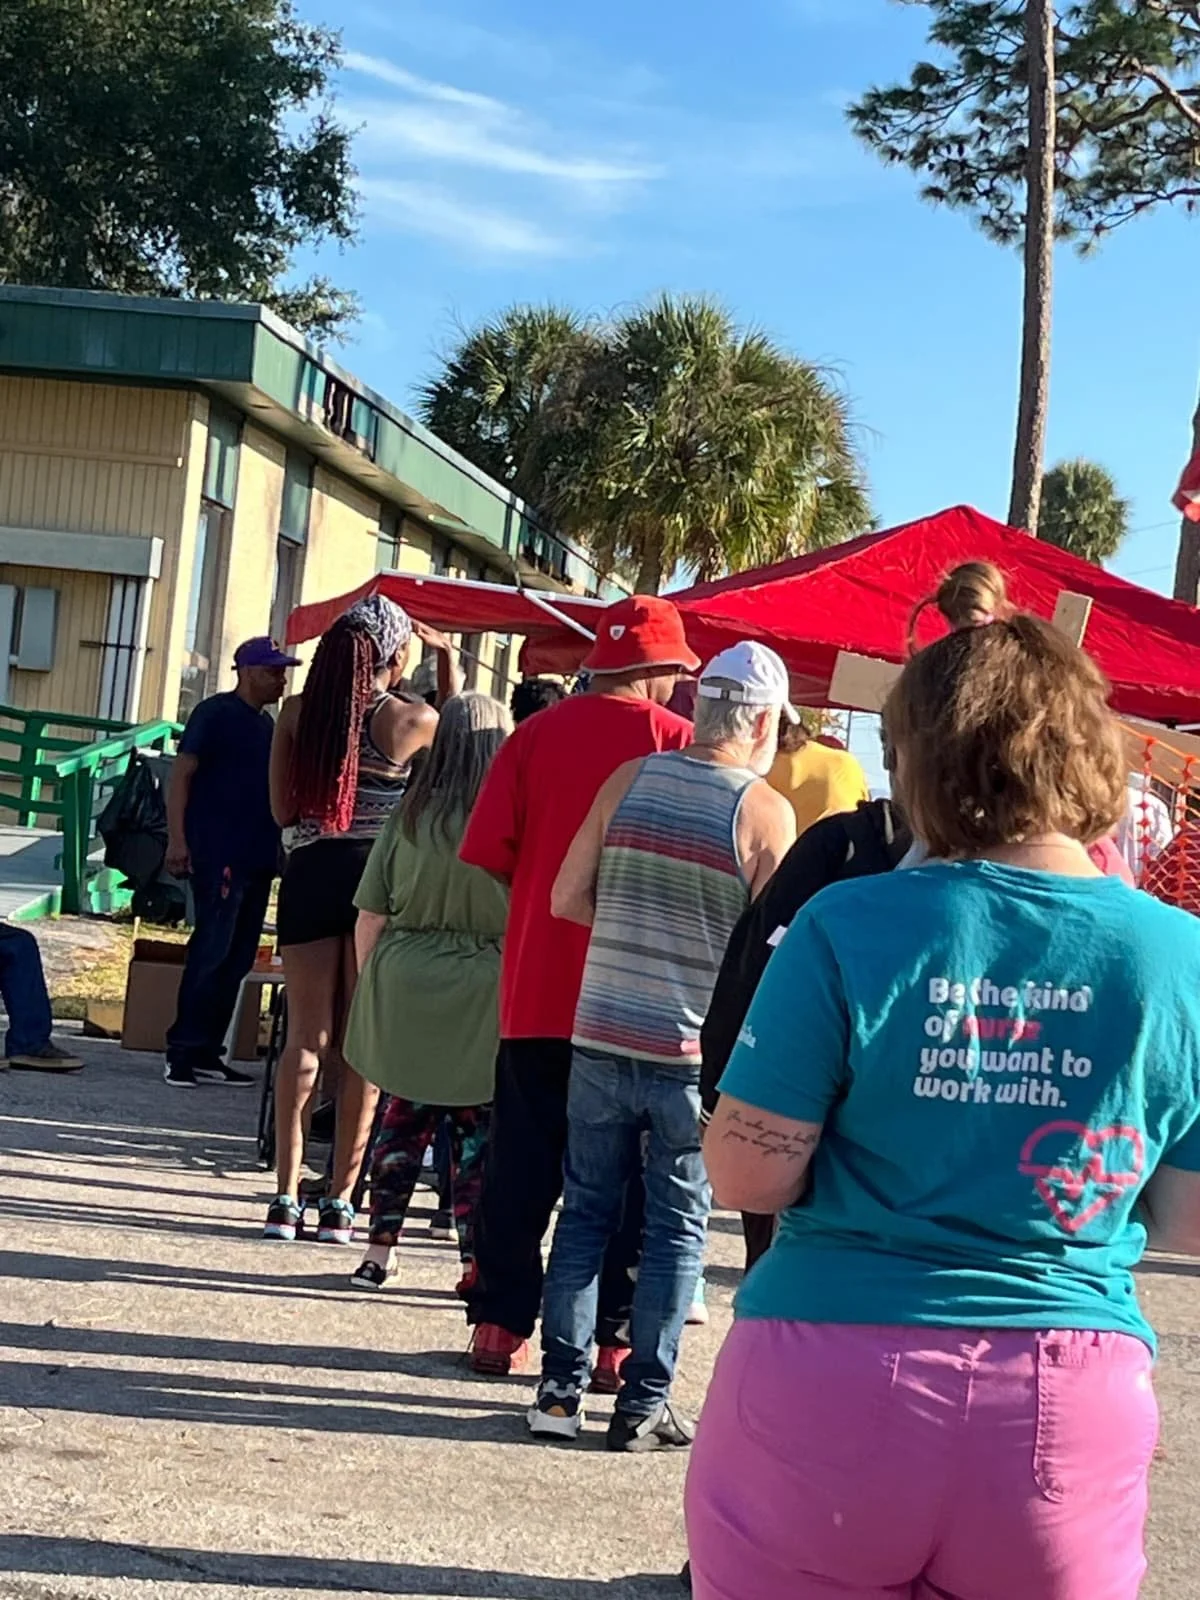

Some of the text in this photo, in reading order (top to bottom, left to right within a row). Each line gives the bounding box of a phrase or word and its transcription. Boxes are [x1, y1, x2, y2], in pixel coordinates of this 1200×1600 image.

[928, 977, 1094, 1012] Be the kind
[923, 1008, 960, 1044] of
[919, 1047, 1093, 1078] you want to
[912, 1076, 1068, 1108] work with.
